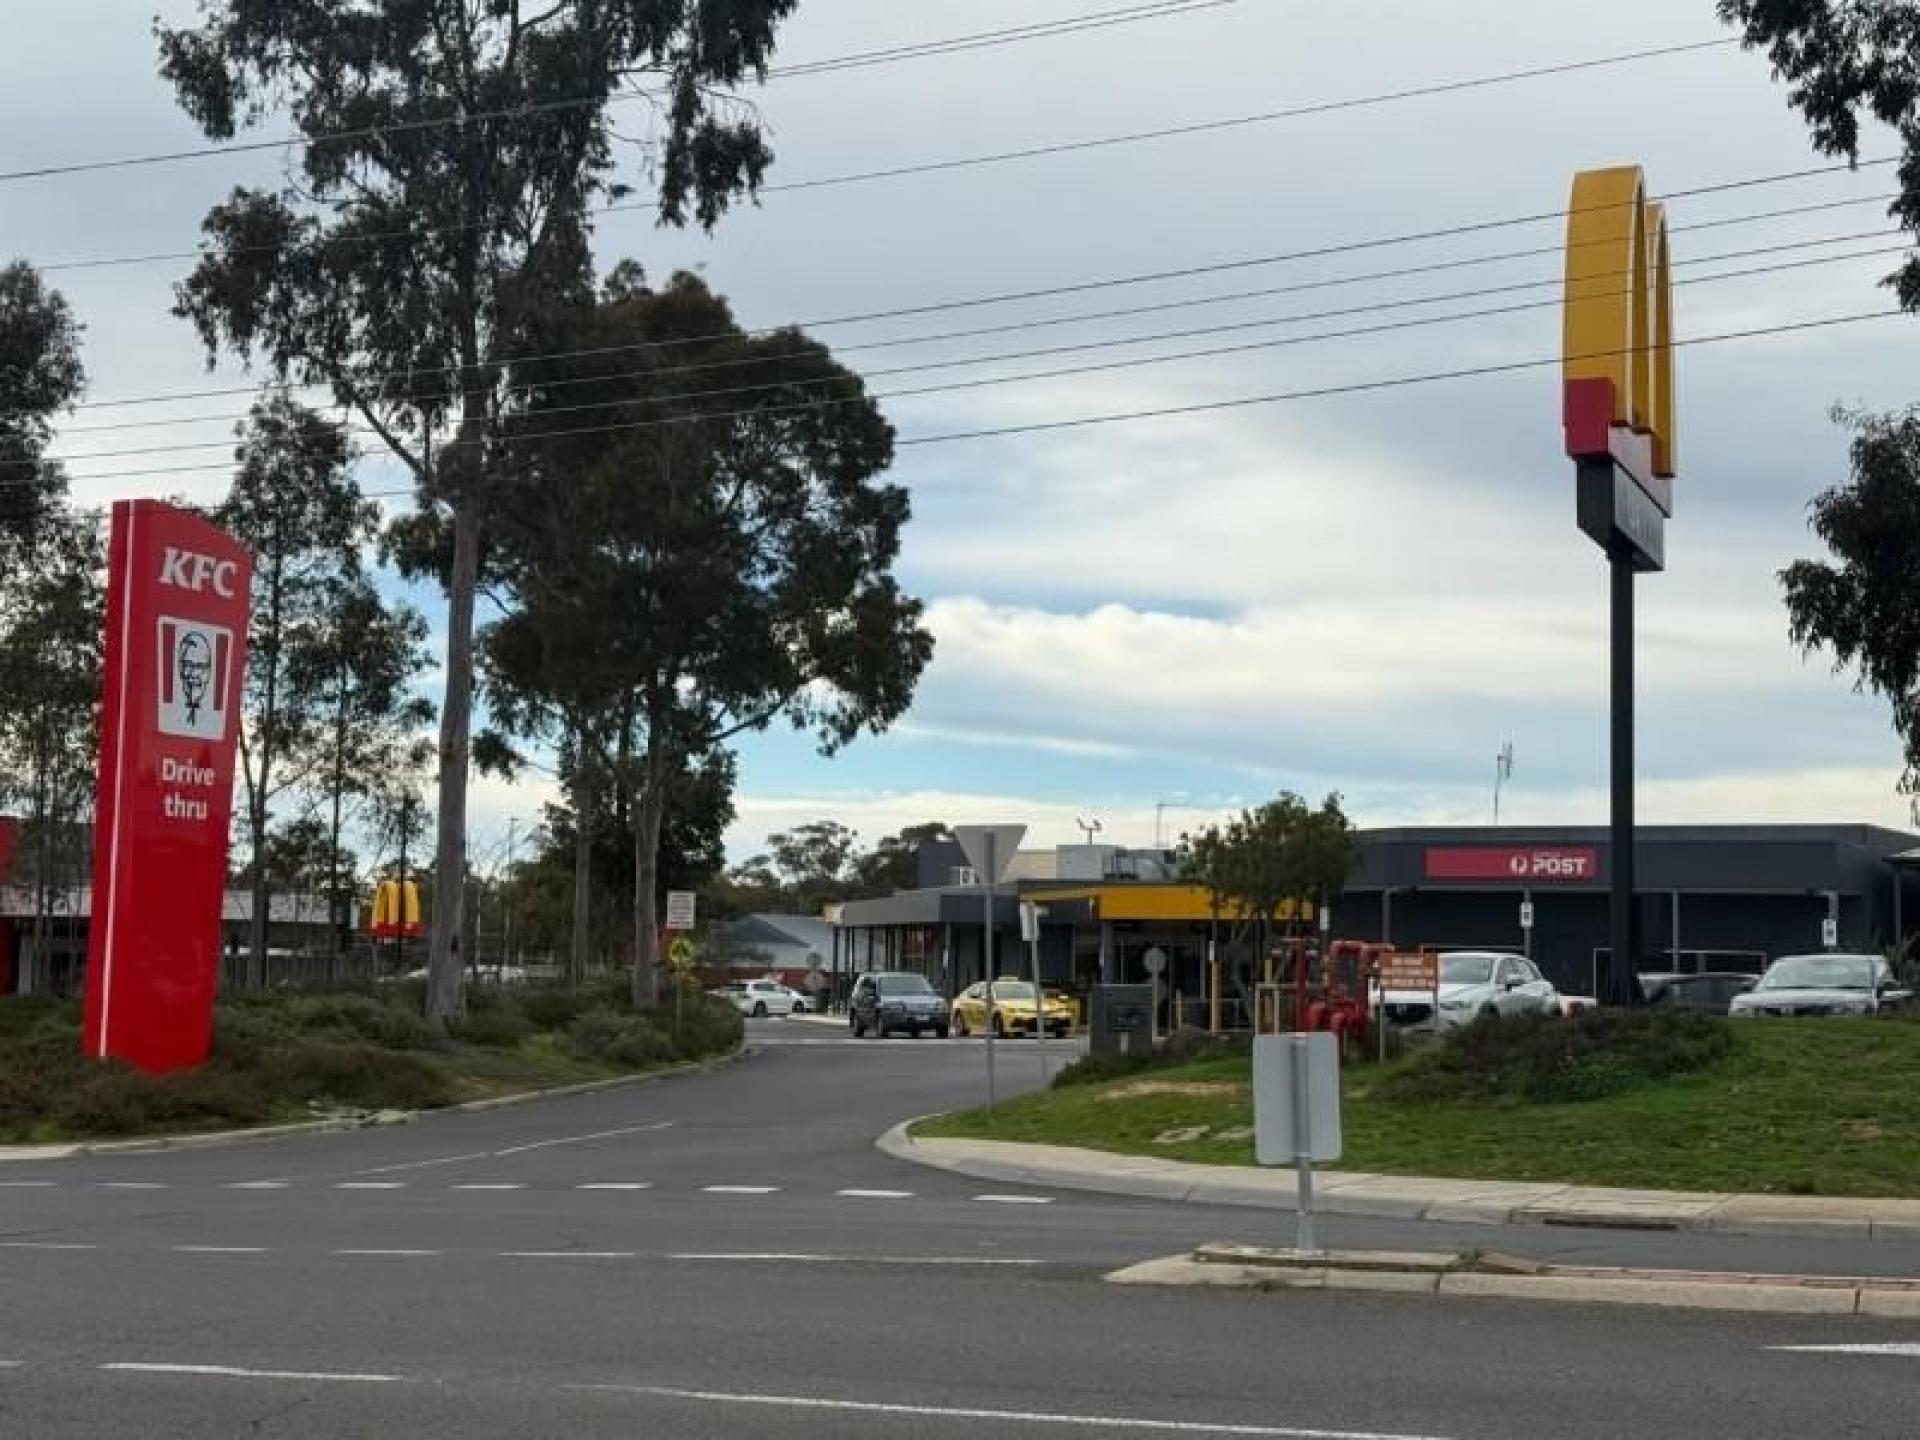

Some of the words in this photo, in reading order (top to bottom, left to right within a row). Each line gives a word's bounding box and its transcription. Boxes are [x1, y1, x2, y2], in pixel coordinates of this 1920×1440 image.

[159, 547, 238, 597] KFC
[162, 757, 216, 786] Drive
[164, 791, 208, 819] thru
[1533, 857, 1586, 875] POST
